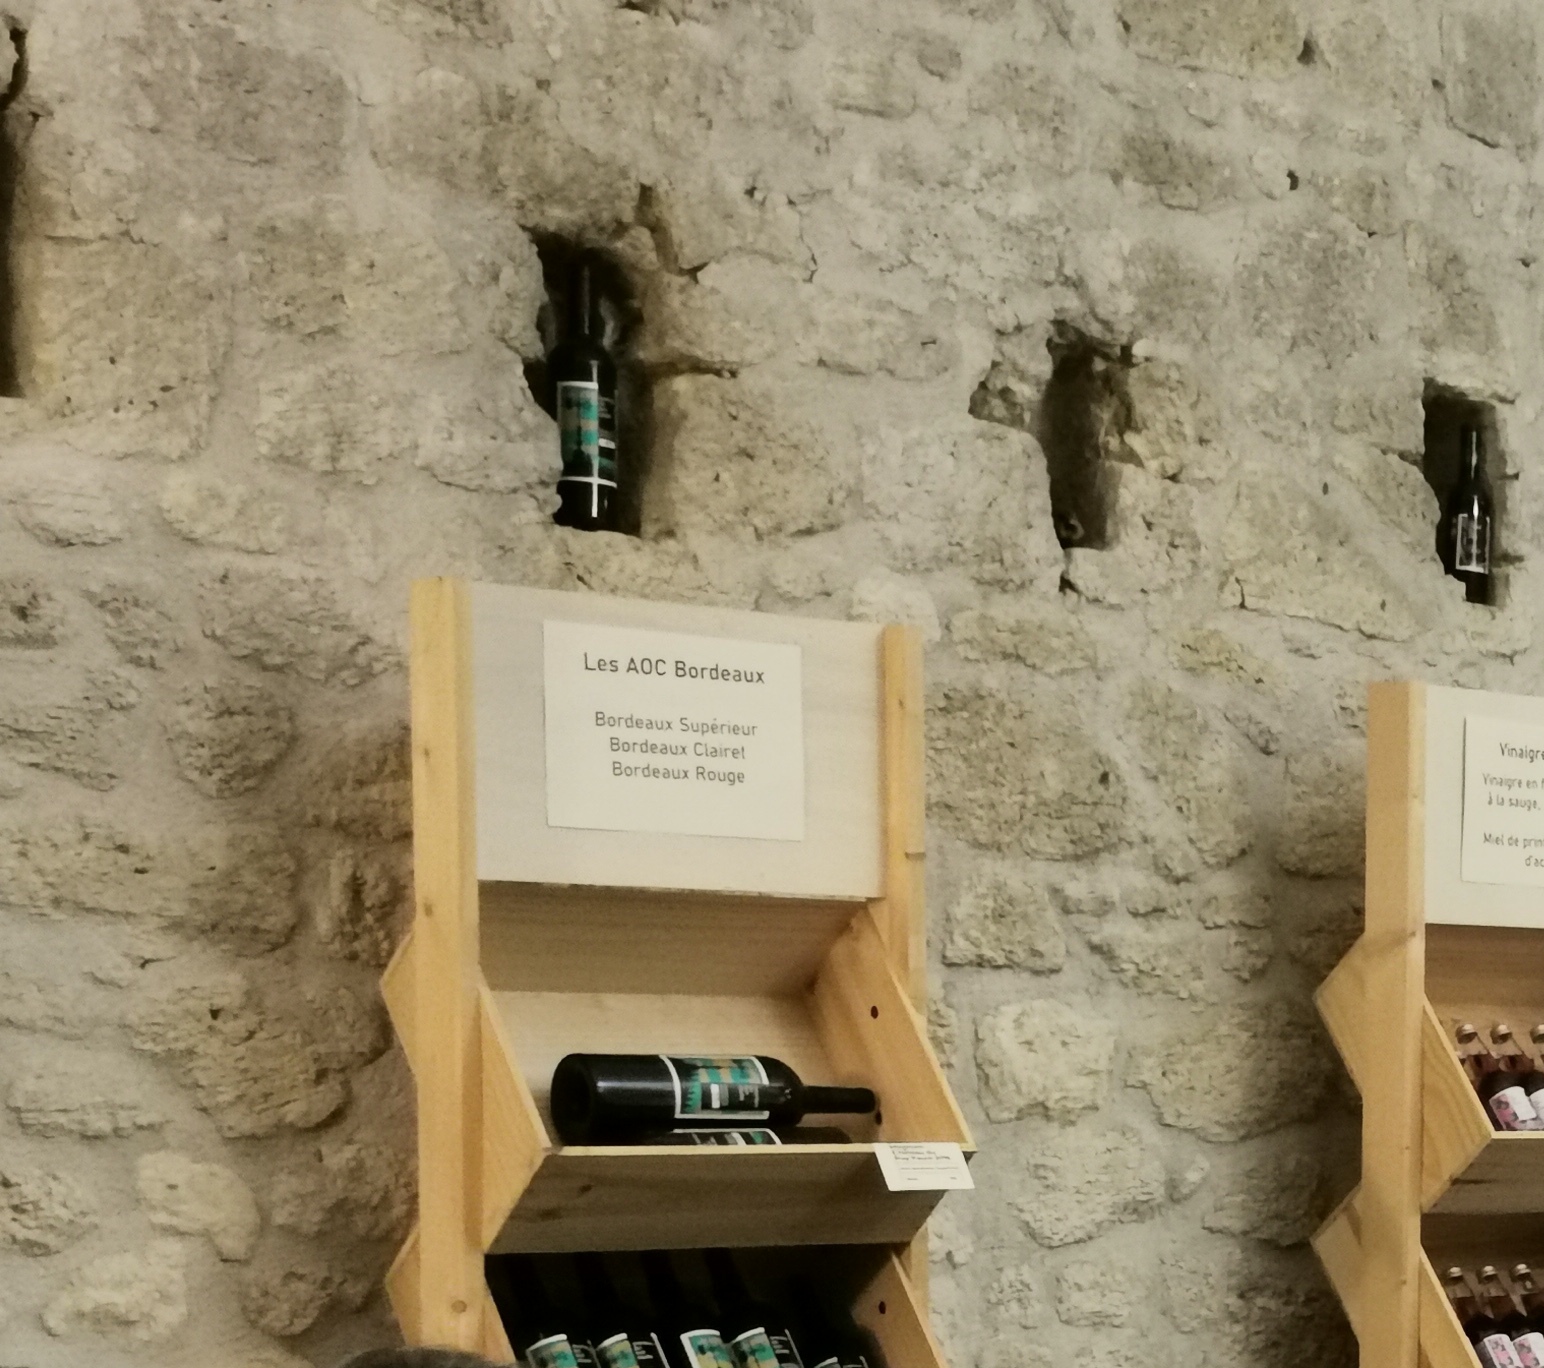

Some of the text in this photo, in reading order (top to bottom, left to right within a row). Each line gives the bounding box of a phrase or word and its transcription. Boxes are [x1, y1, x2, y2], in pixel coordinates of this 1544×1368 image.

[583, 652, 765, 684] Les AOC Bordeaux
[595, 711, 758, 737] Bordeaux Supérieur
[609, 737, 746, 760] Bordeaux Clairet
[612, 761, 745, 786] Bordeaux Rouge
[1482, 772, 1522, 791] Vinaigre
[1526, 779, 1538, 789] en
[1483, 832, 1504, 846] Miel
[1507, 835, 1519, 847] de
